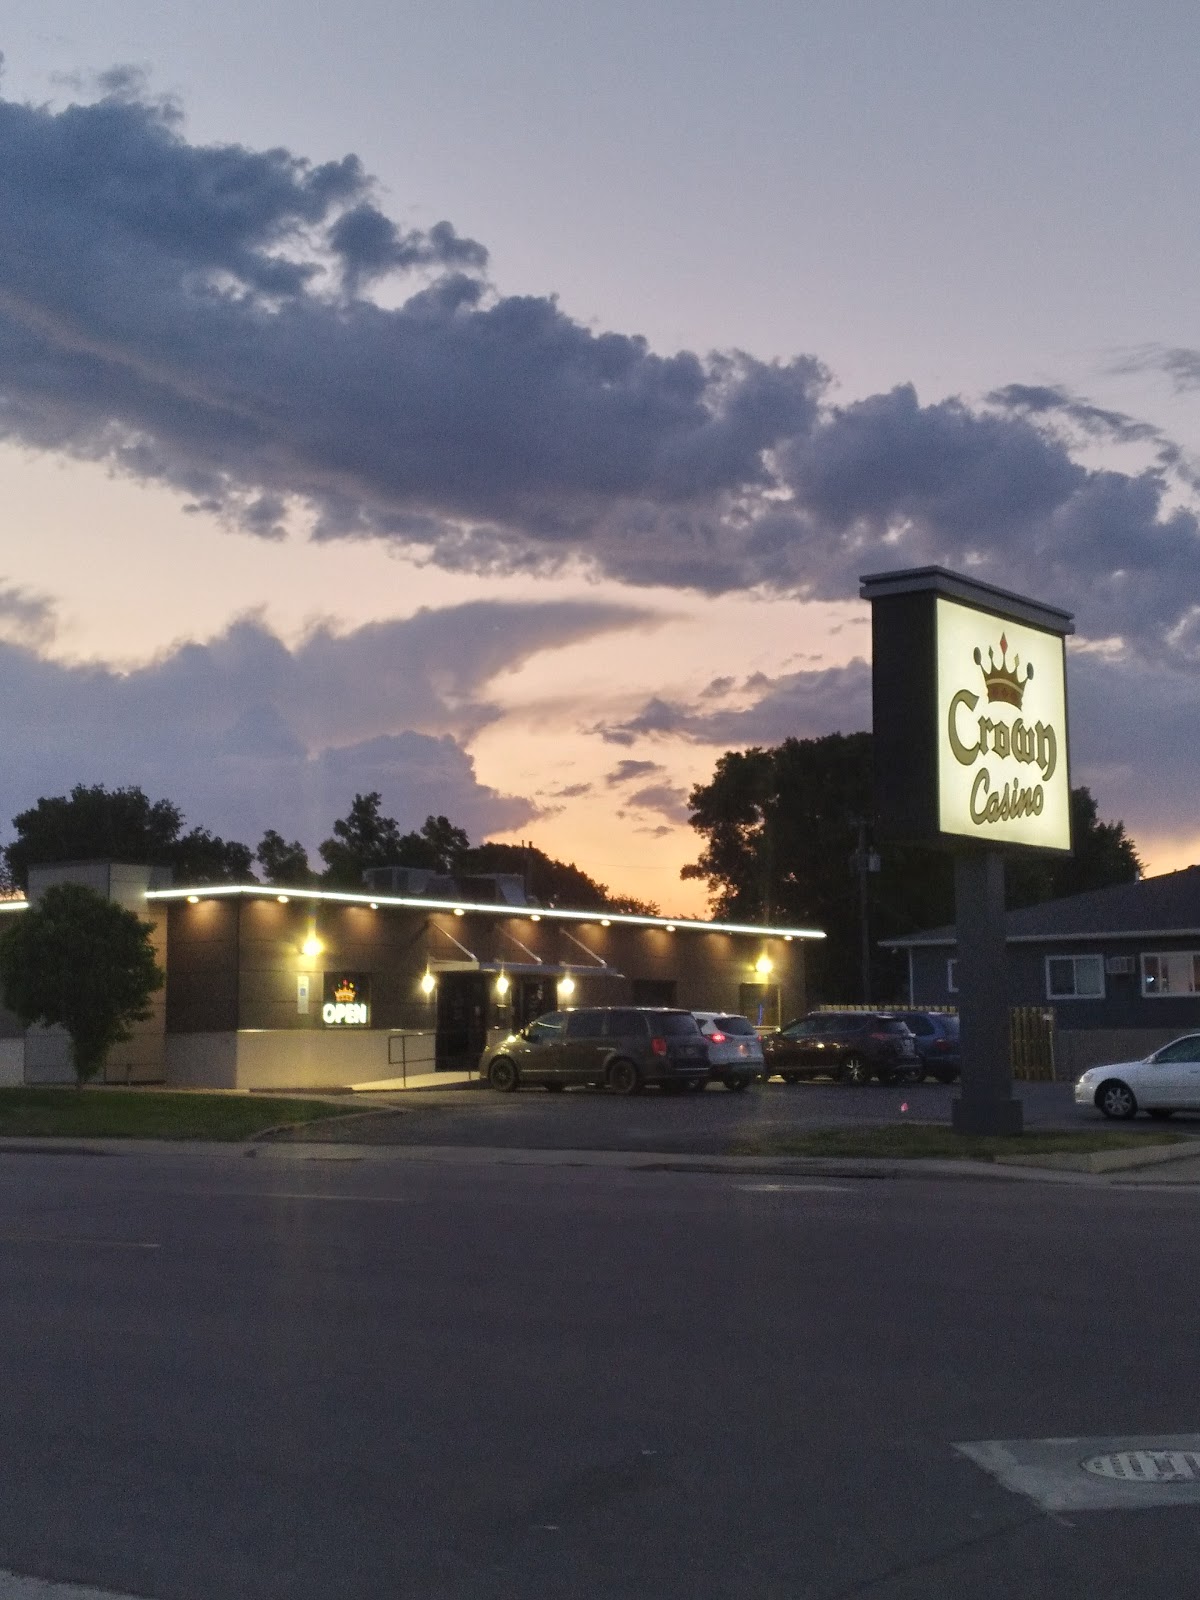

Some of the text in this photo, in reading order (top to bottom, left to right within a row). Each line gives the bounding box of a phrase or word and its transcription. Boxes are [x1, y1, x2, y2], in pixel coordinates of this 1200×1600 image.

[948, 689, 1057, 781] Crown
[970, 767, 1044, 825] Casino
[323, 1003, 367, 1024] OPEN
